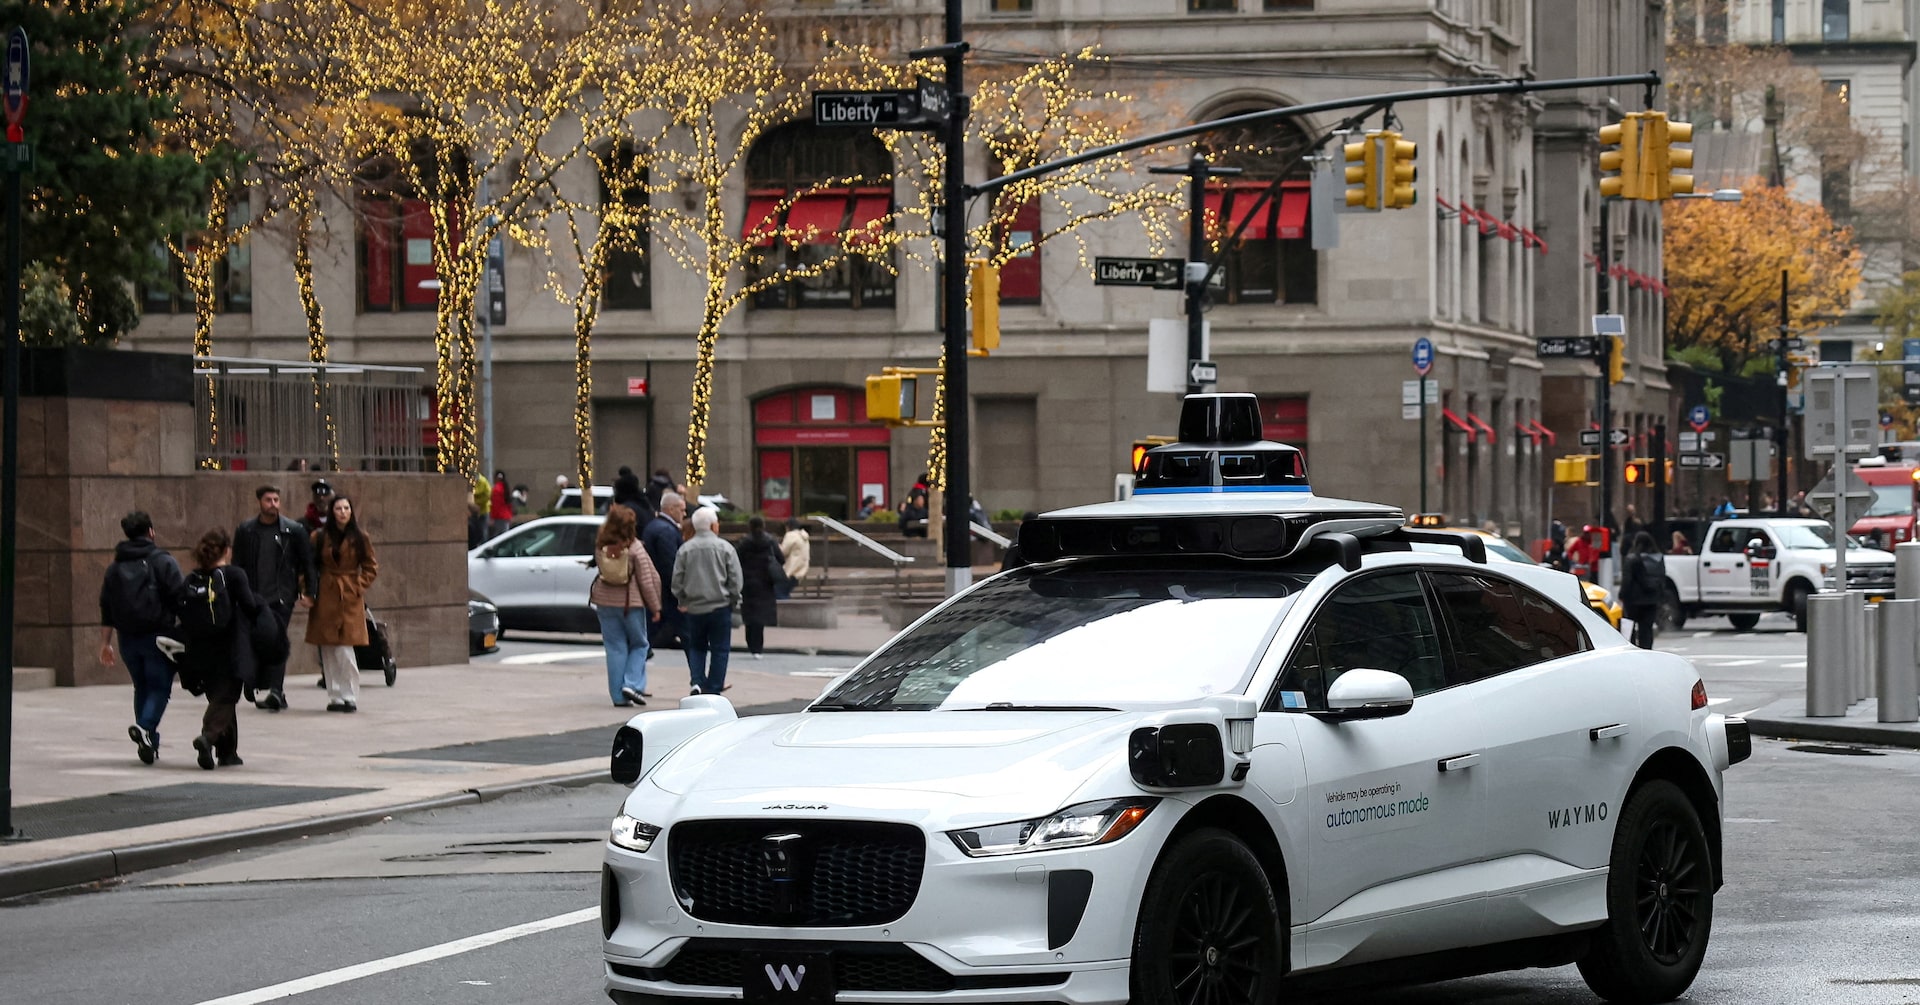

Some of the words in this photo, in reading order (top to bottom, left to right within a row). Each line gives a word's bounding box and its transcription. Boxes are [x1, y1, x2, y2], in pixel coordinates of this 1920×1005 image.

[821, 102, 880, 123] Liberty
[1101, 264, 1144, 283] Liberty
[1325, 790, 1346, 803] Vehicle
[1346, 791, 1359, 801] may
[1359, 788, 1368, 798] be
[1368, 784, 1395, 798] operating
[1395, 781, 1402, 792] in
[1326, 802, 1396, 828] autonomous
[1398, 792, 1429, 815] mode
[1548, 801, 1608, 829] WAYMO
